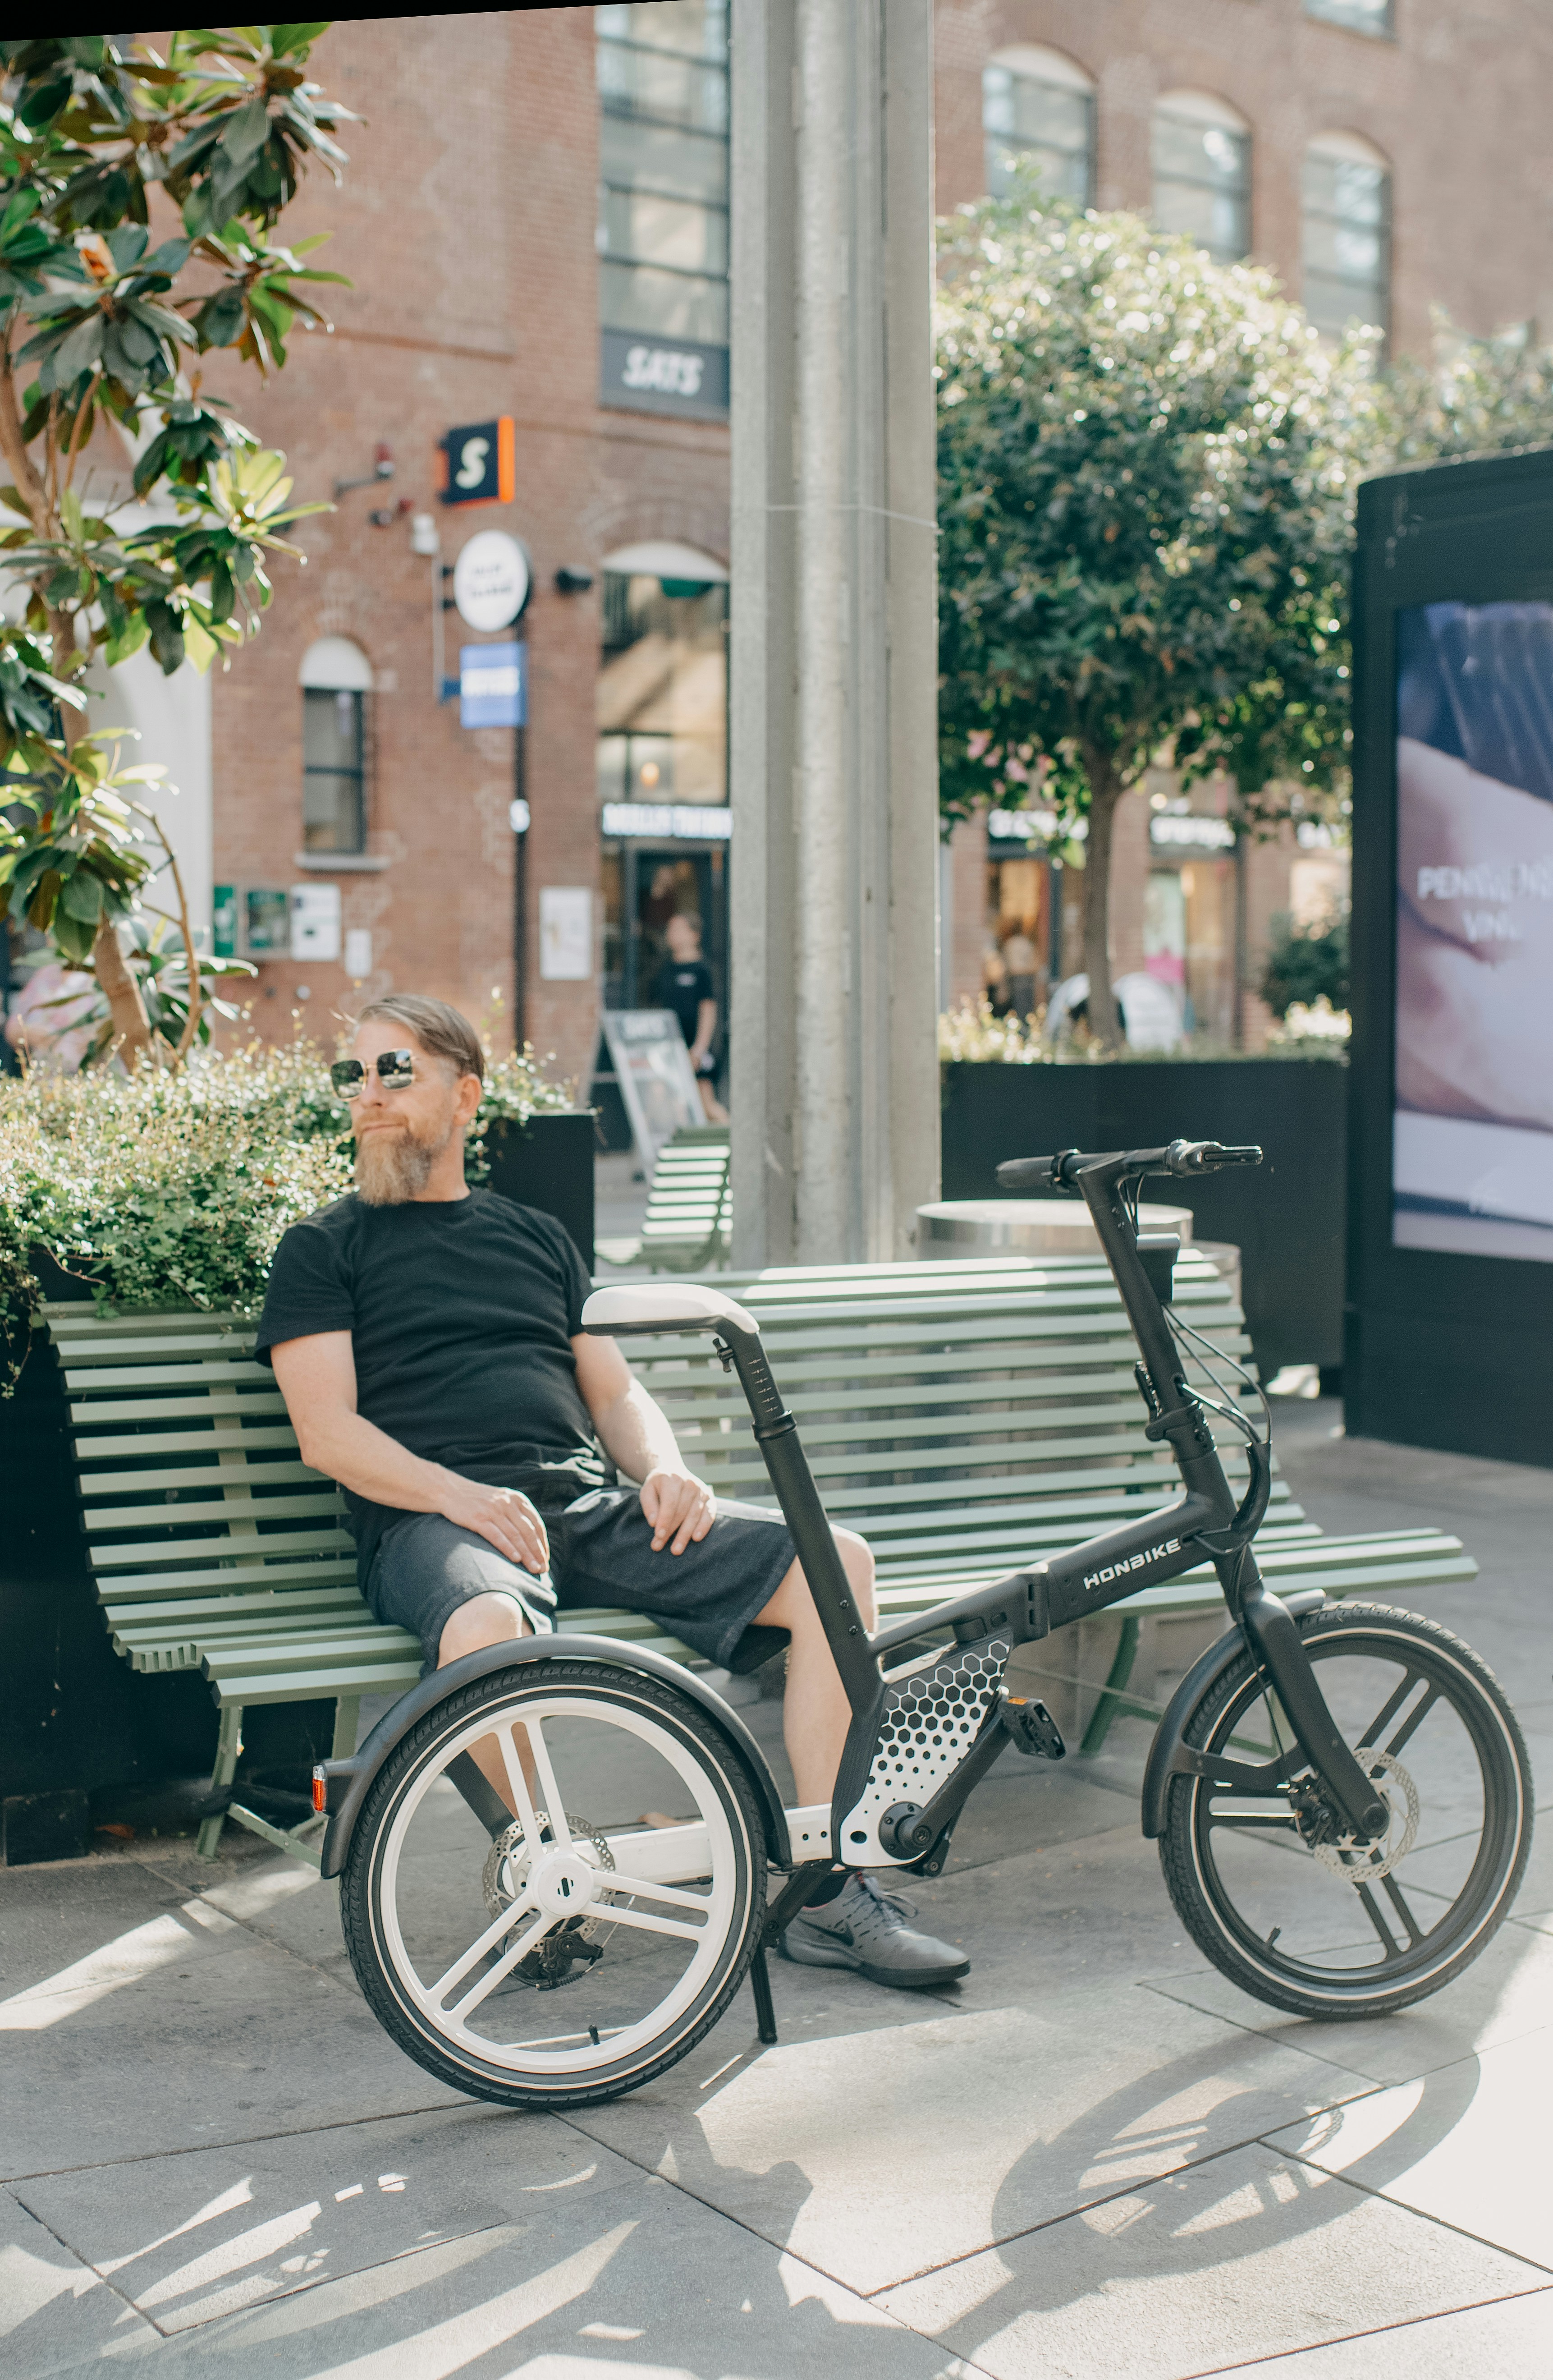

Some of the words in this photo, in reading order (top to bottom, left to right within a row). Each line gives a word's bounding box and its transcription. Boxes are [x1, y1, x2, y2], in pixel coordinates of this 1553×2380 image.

[622, 345, 705, 397] SATS
[455, 436, 490, 489] S
[1083, 1538, 1182, 1590] HONBIKE
